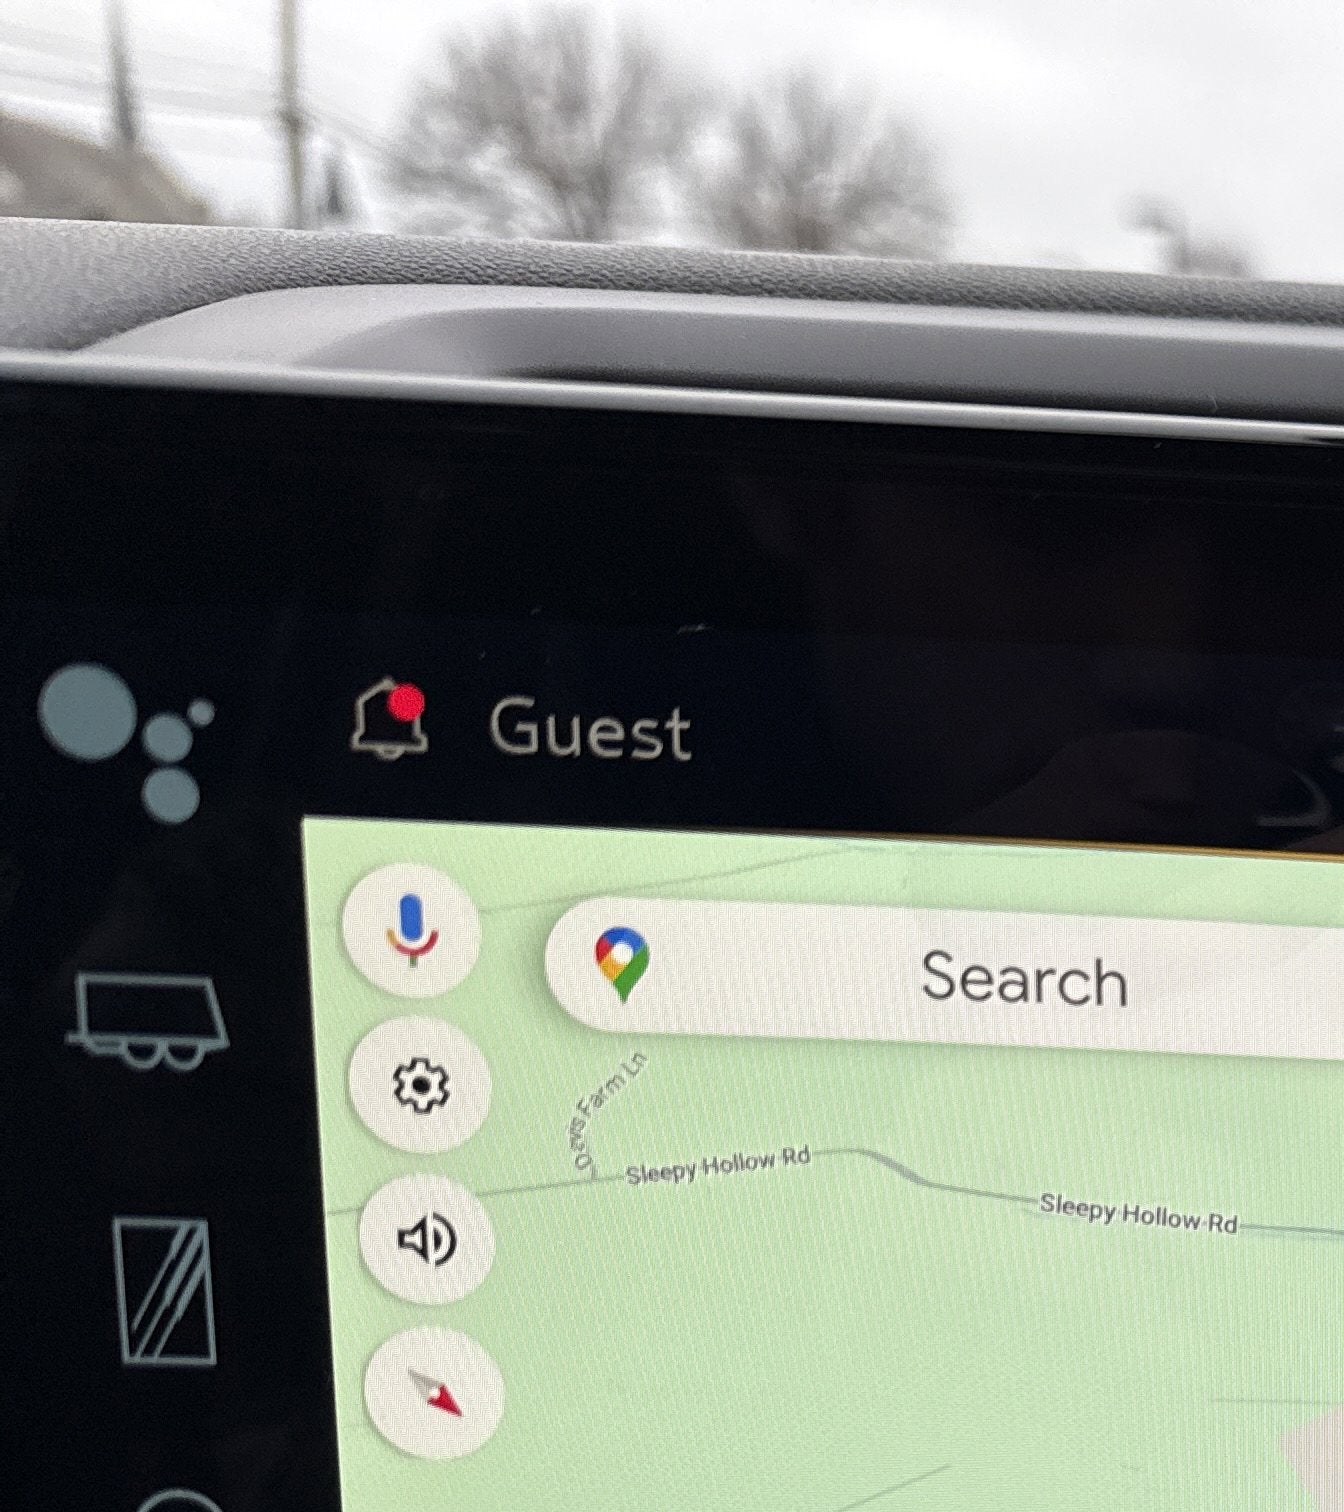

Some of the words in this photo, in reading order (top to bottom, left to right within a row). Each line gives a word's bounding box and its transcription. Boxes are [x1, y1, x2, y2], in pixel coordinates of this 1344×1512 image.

[490, 696, 693, 761] Guest
[923, 950, 1127, 1006] Search
[576, 1074, 626, 1117] Farm
[621, 1053, 648, 1077] Ln
[626, 1162, 697, 1187] Sleepy
[703, 1151, 776, 1178] Hollow
[781, 1145, 812, 1166] Rd
[1040, 1194, 1117, 1224] Sleepy
[1122, 1205, 1201, 1229] Hollow
[1207, 1212, 1238, 1234] Rd
